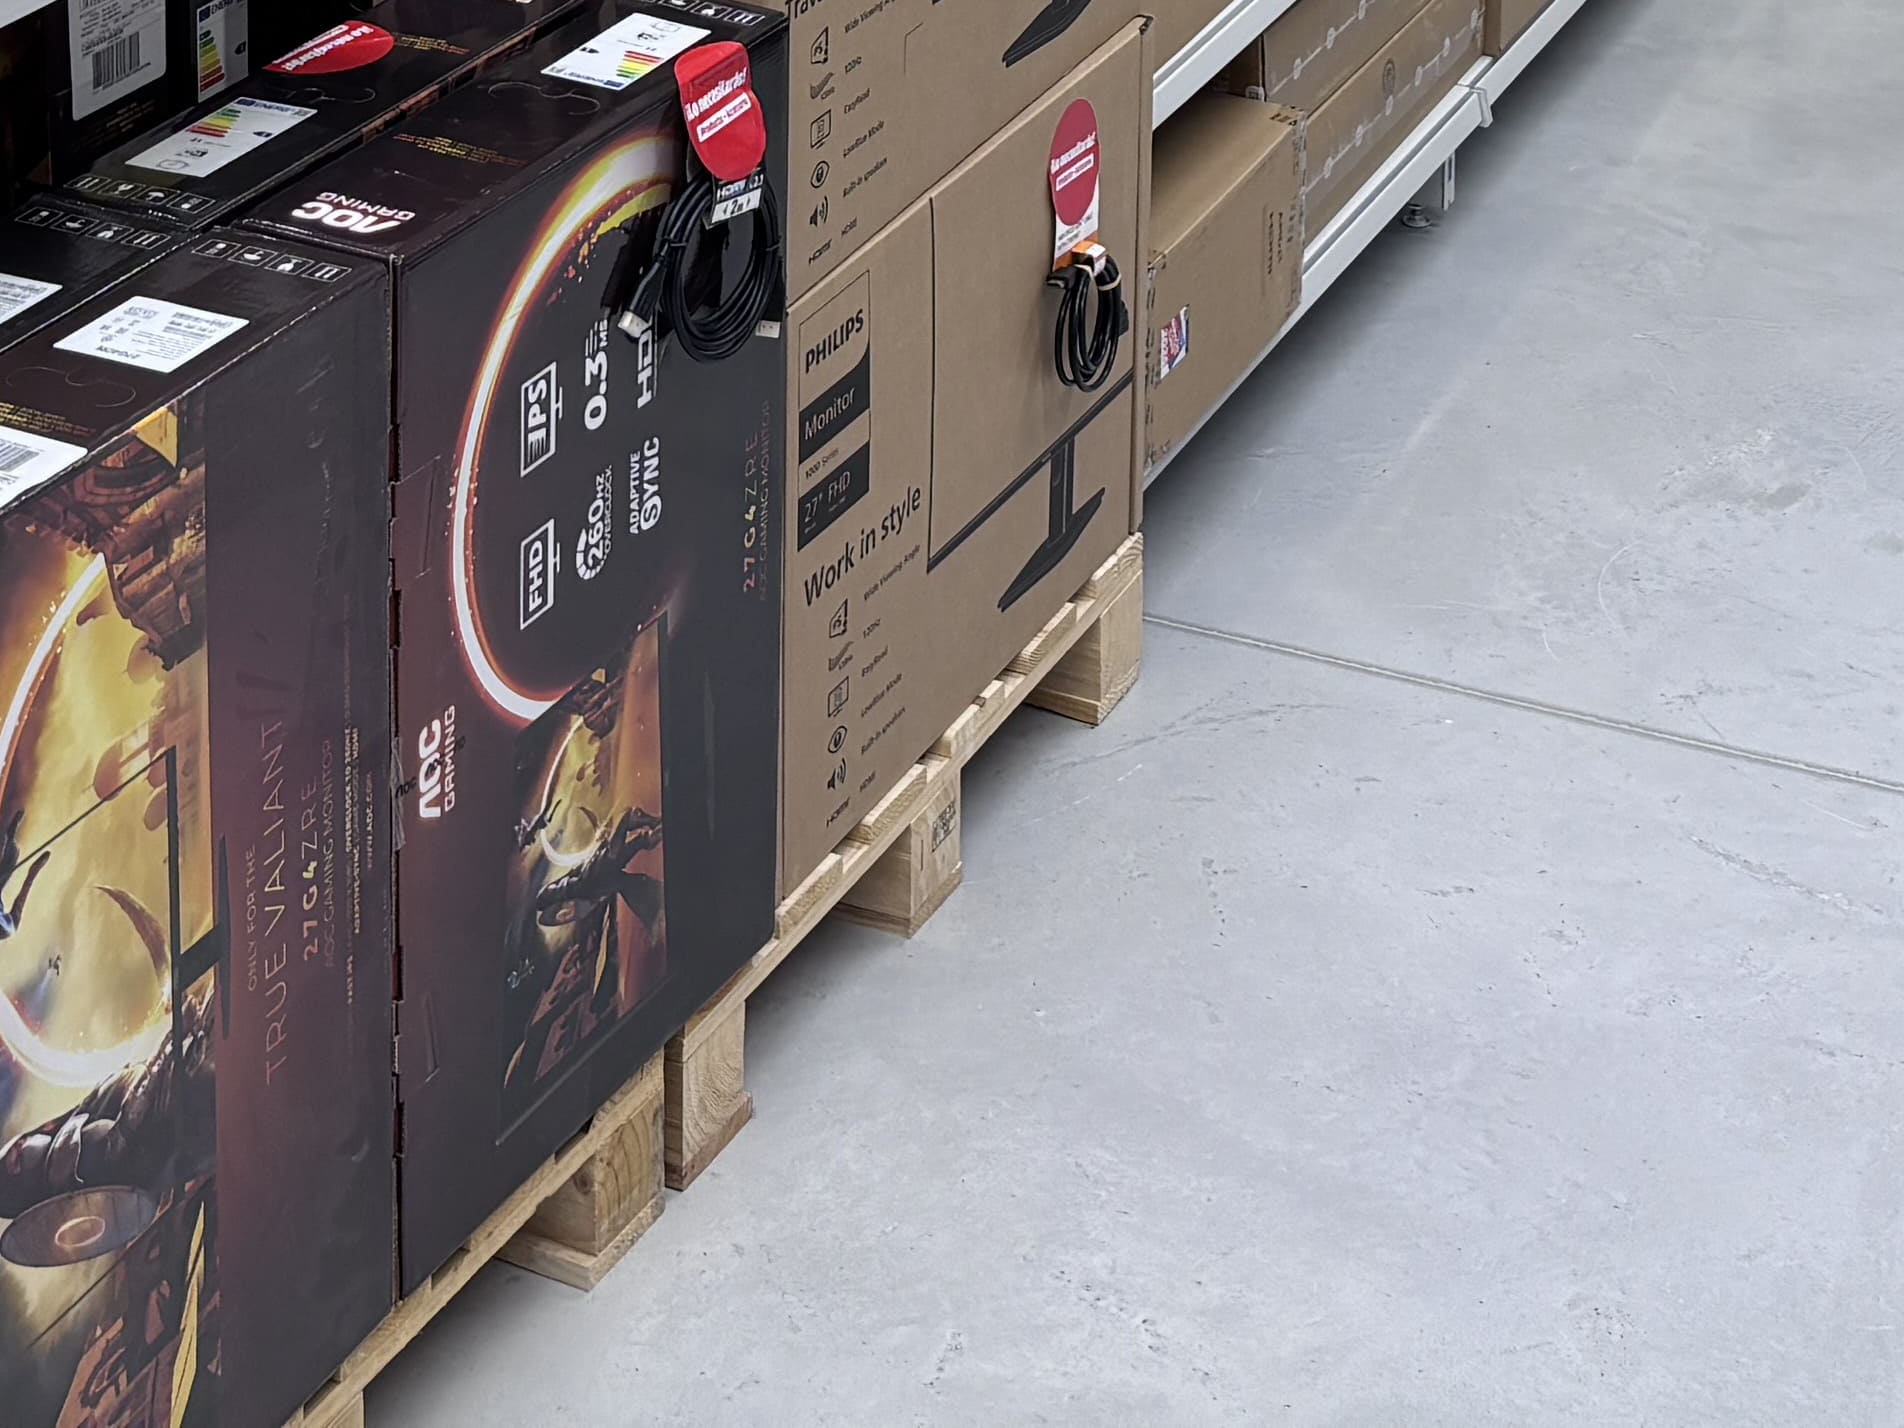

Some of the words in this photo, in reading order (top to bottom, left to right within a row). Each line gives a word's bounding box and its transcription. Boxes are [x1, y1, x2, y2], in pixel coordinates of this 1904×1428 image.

[804, 308, 865, 376] PHILIPS
[584, 354, 609, 432] 0.3
[803, 387, 857, 442] Monitor
[629, 449, 641, 534] ADAPTIVE
[827, 470, 852, 505] FHD
[528, 541, 548, 620] FHD
[803, 554, 856, 608] Work
[857, 533, 877, 572] in
[878, 482, 922, 548] style
[418, 718, 443, 822] AOC
[443, 704, 459, 811] GAMING
